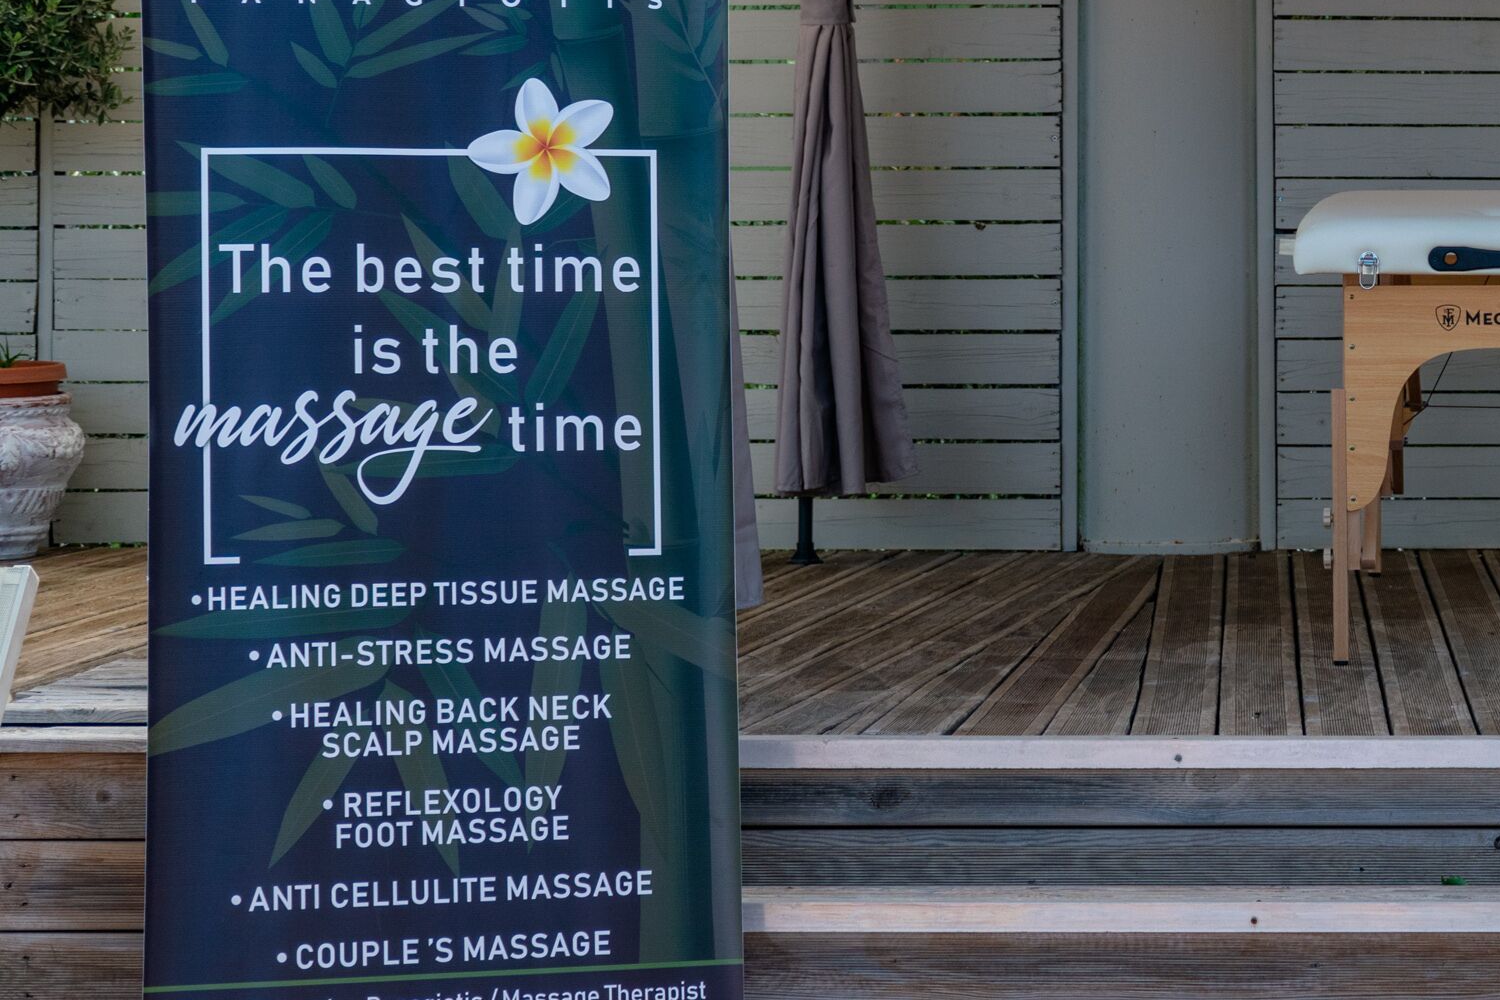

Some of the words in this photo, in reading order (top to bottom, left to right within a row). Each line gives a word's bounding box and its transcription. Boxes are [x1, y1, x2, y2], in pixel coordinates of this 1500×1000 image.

[218, 243, 332, 294] The
[356, 243, 485, 294] best
[507, 243, 640, 294] time
[354, 324, 401, 375] is
[422, 324, 518, 375] the
[173, 389, 494, 506] massage
[508, 402, 642, 453] time
[208, 583, 341, 611] HEALING
[351, 582, 427, 608] DEEP
[433, 580, 538, 606] TISSUE
[547, 576, 685, 604] MASSAGE
[266, 639, 474, 669] ANTI-STRESS
[484, 634, 631, 664] MASSAGE
[290, 699, 426, 729] HEALING
[436, 696, 520, 724] BACK
[529, 693, 612, 721] NECK
[322, 730, 423, 759] SCALP
[432, 725, 580, 755] MASSAGE
[344, 785, 562, 818] REFLEXOLOGY
[336, 821, 414, 849] FOOT
[422, 815, 569, 846] MASSAGE
[248, 883, 320, 912] ANTI
[331, 876, 497, 909] CELLULITE
[507, 870, 653, 901] MASSAGE
[463, 930, 611, 962] MASSAGE
